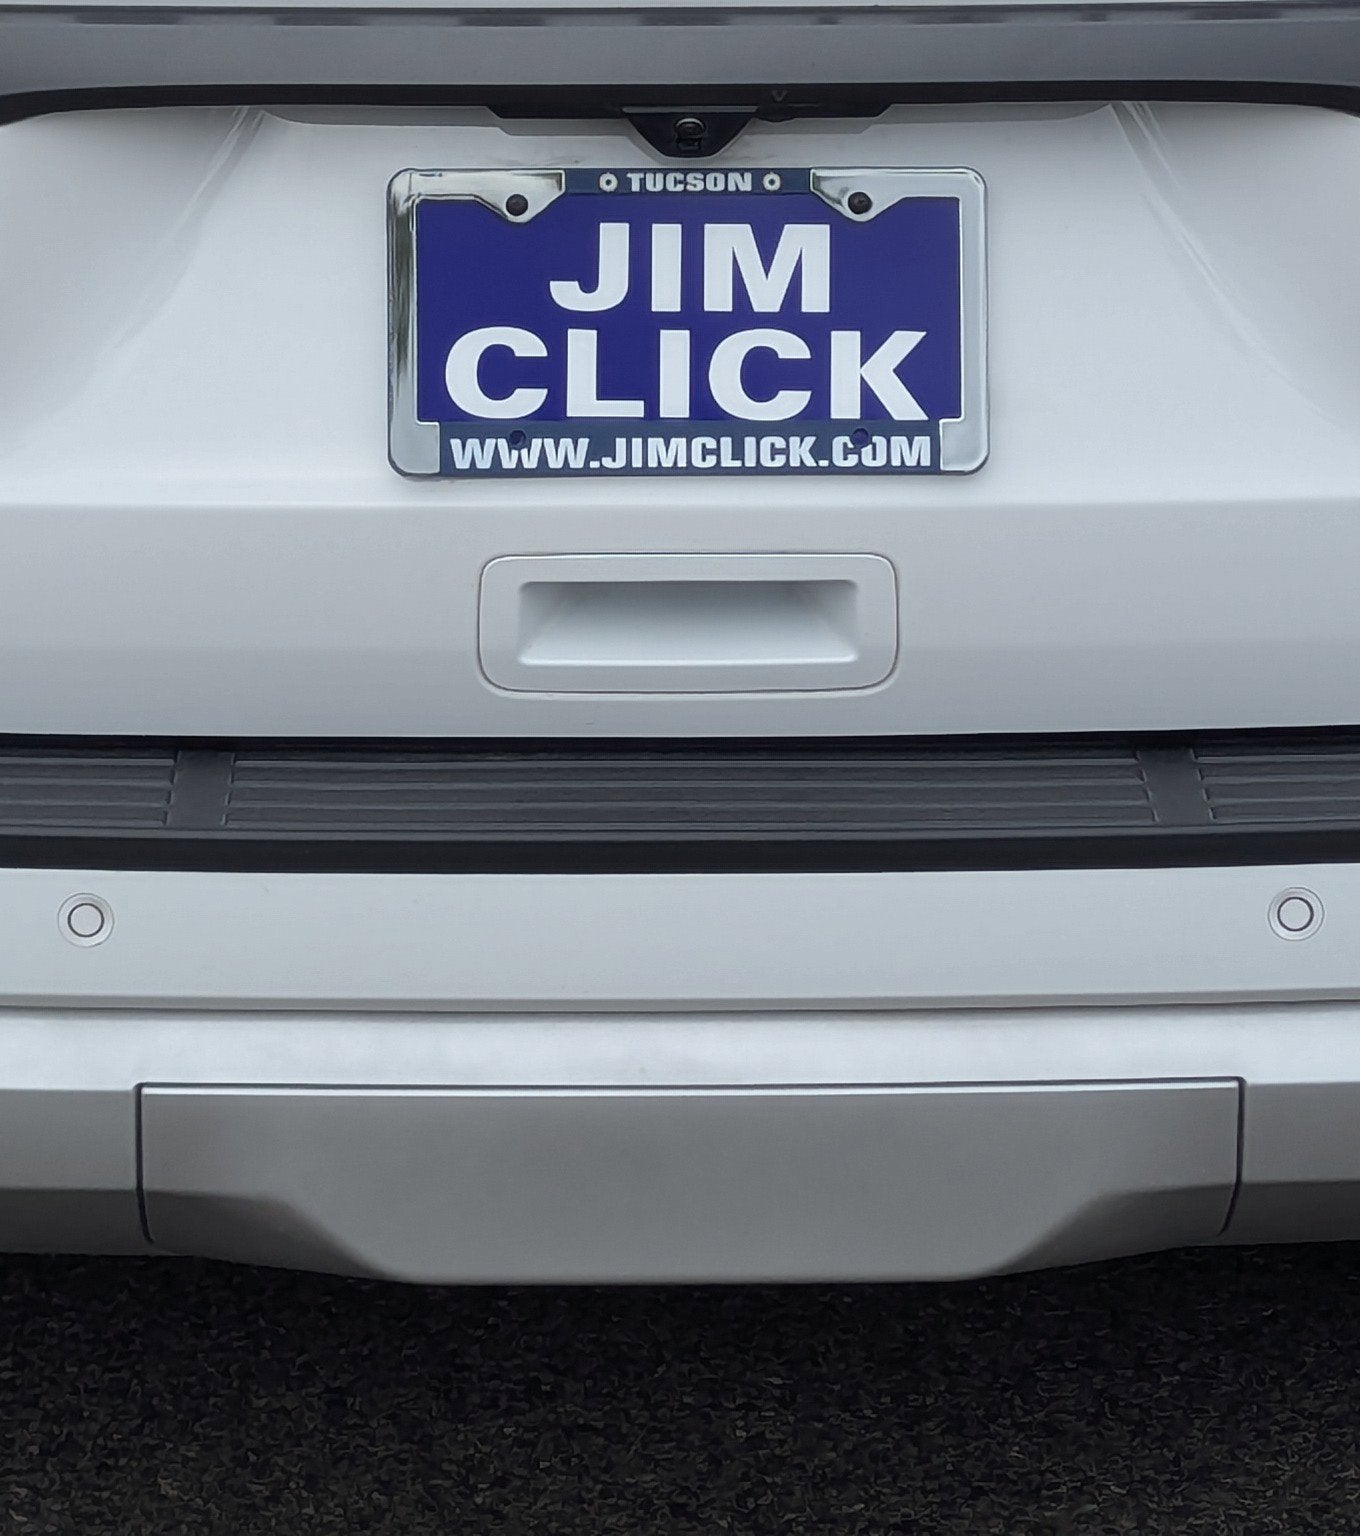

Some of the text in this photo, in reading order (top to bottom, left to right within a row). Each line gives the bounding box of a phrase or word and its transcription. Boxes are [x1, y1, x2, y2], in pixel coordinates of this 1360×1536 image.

[626, 172, 753, 193] TUCSON
[548, 221, 831, 314] JIM
[444, 325, 930, 422] CLICK
[450, 435, 931, 469] WWW.JIMCLICK.COM
